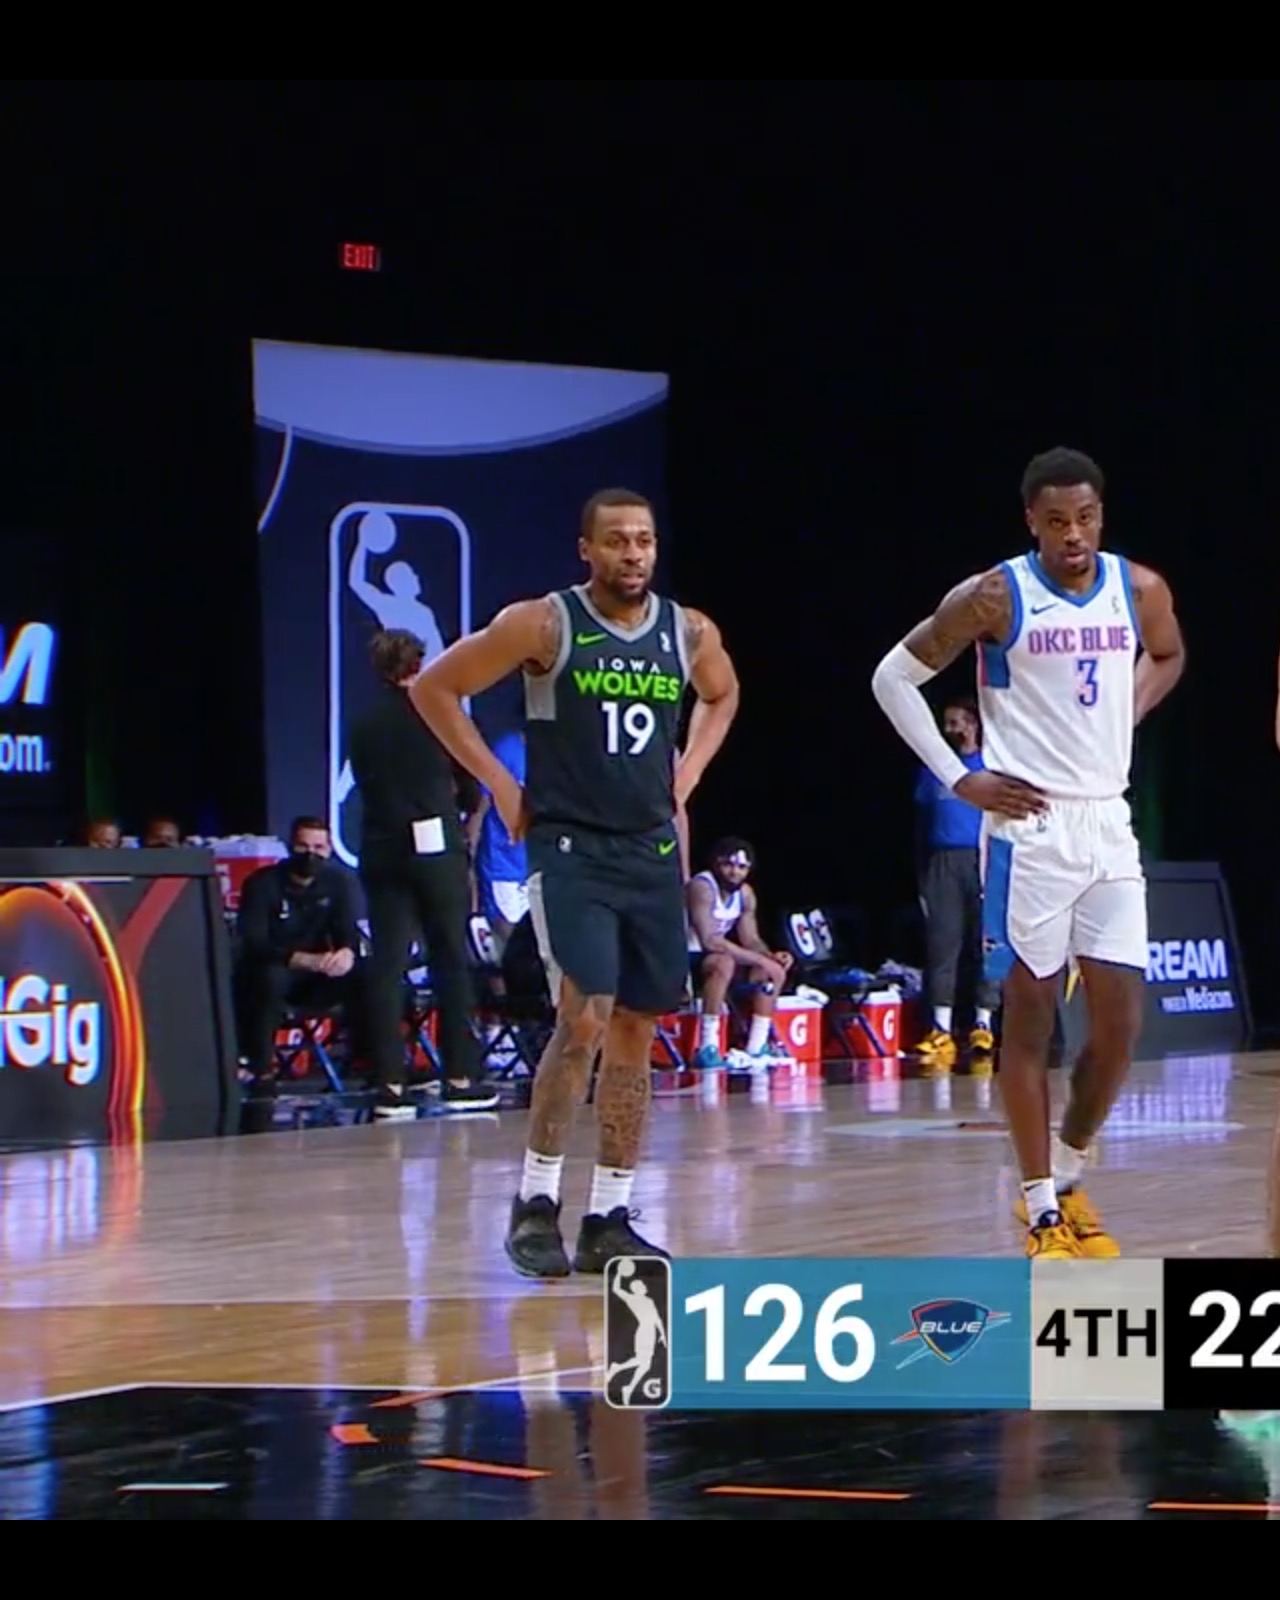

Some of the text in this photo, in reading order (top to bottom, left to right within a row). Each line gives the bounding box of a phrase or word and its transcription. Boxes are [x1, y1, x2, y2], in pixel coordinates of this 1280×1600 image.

[343, 243, 375, 269] EXIT
[1028, 625, 1130, 655] OKC BLUE
[597, 657, 661, 674] IOWA
[573, 668, 681, 702] WOLVES
[1077, 658, 1099, 708] 3
[601, 700, 656, 755] 19
[789, 1013, 808, 1047] G
